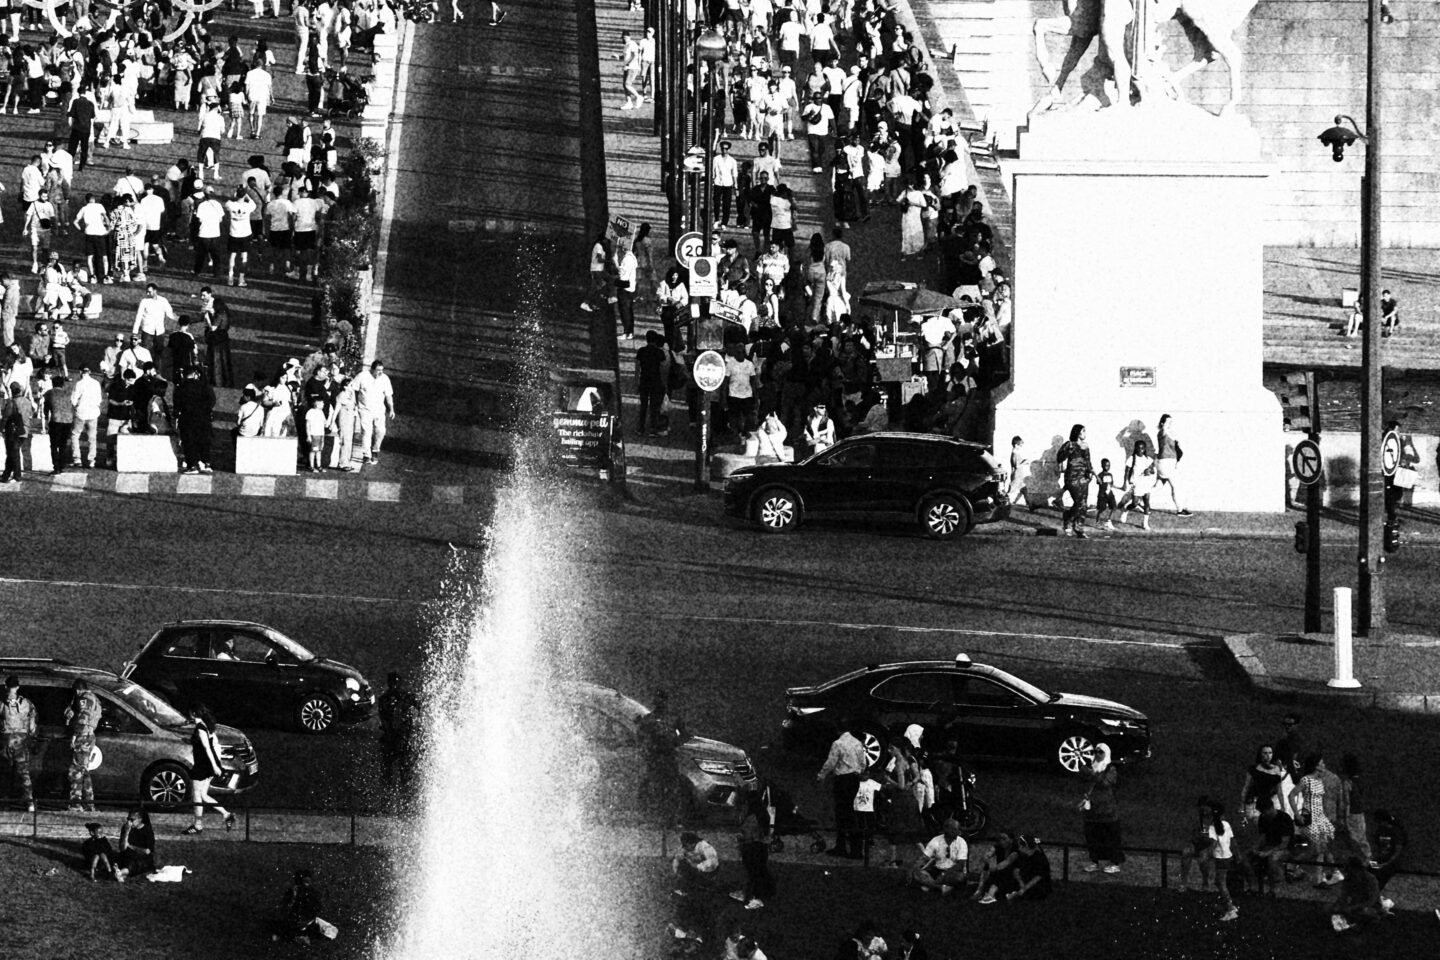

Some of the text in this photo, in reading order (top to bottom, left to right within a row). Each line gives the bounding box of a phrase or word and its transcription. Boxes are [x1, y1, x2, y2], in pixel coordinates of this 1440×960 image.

[616, 218, 628, 228] NO
[685, 244, 703, 257] 20
[558, 428, 571, 437] The
[561, 437, 584, 447] hailing
